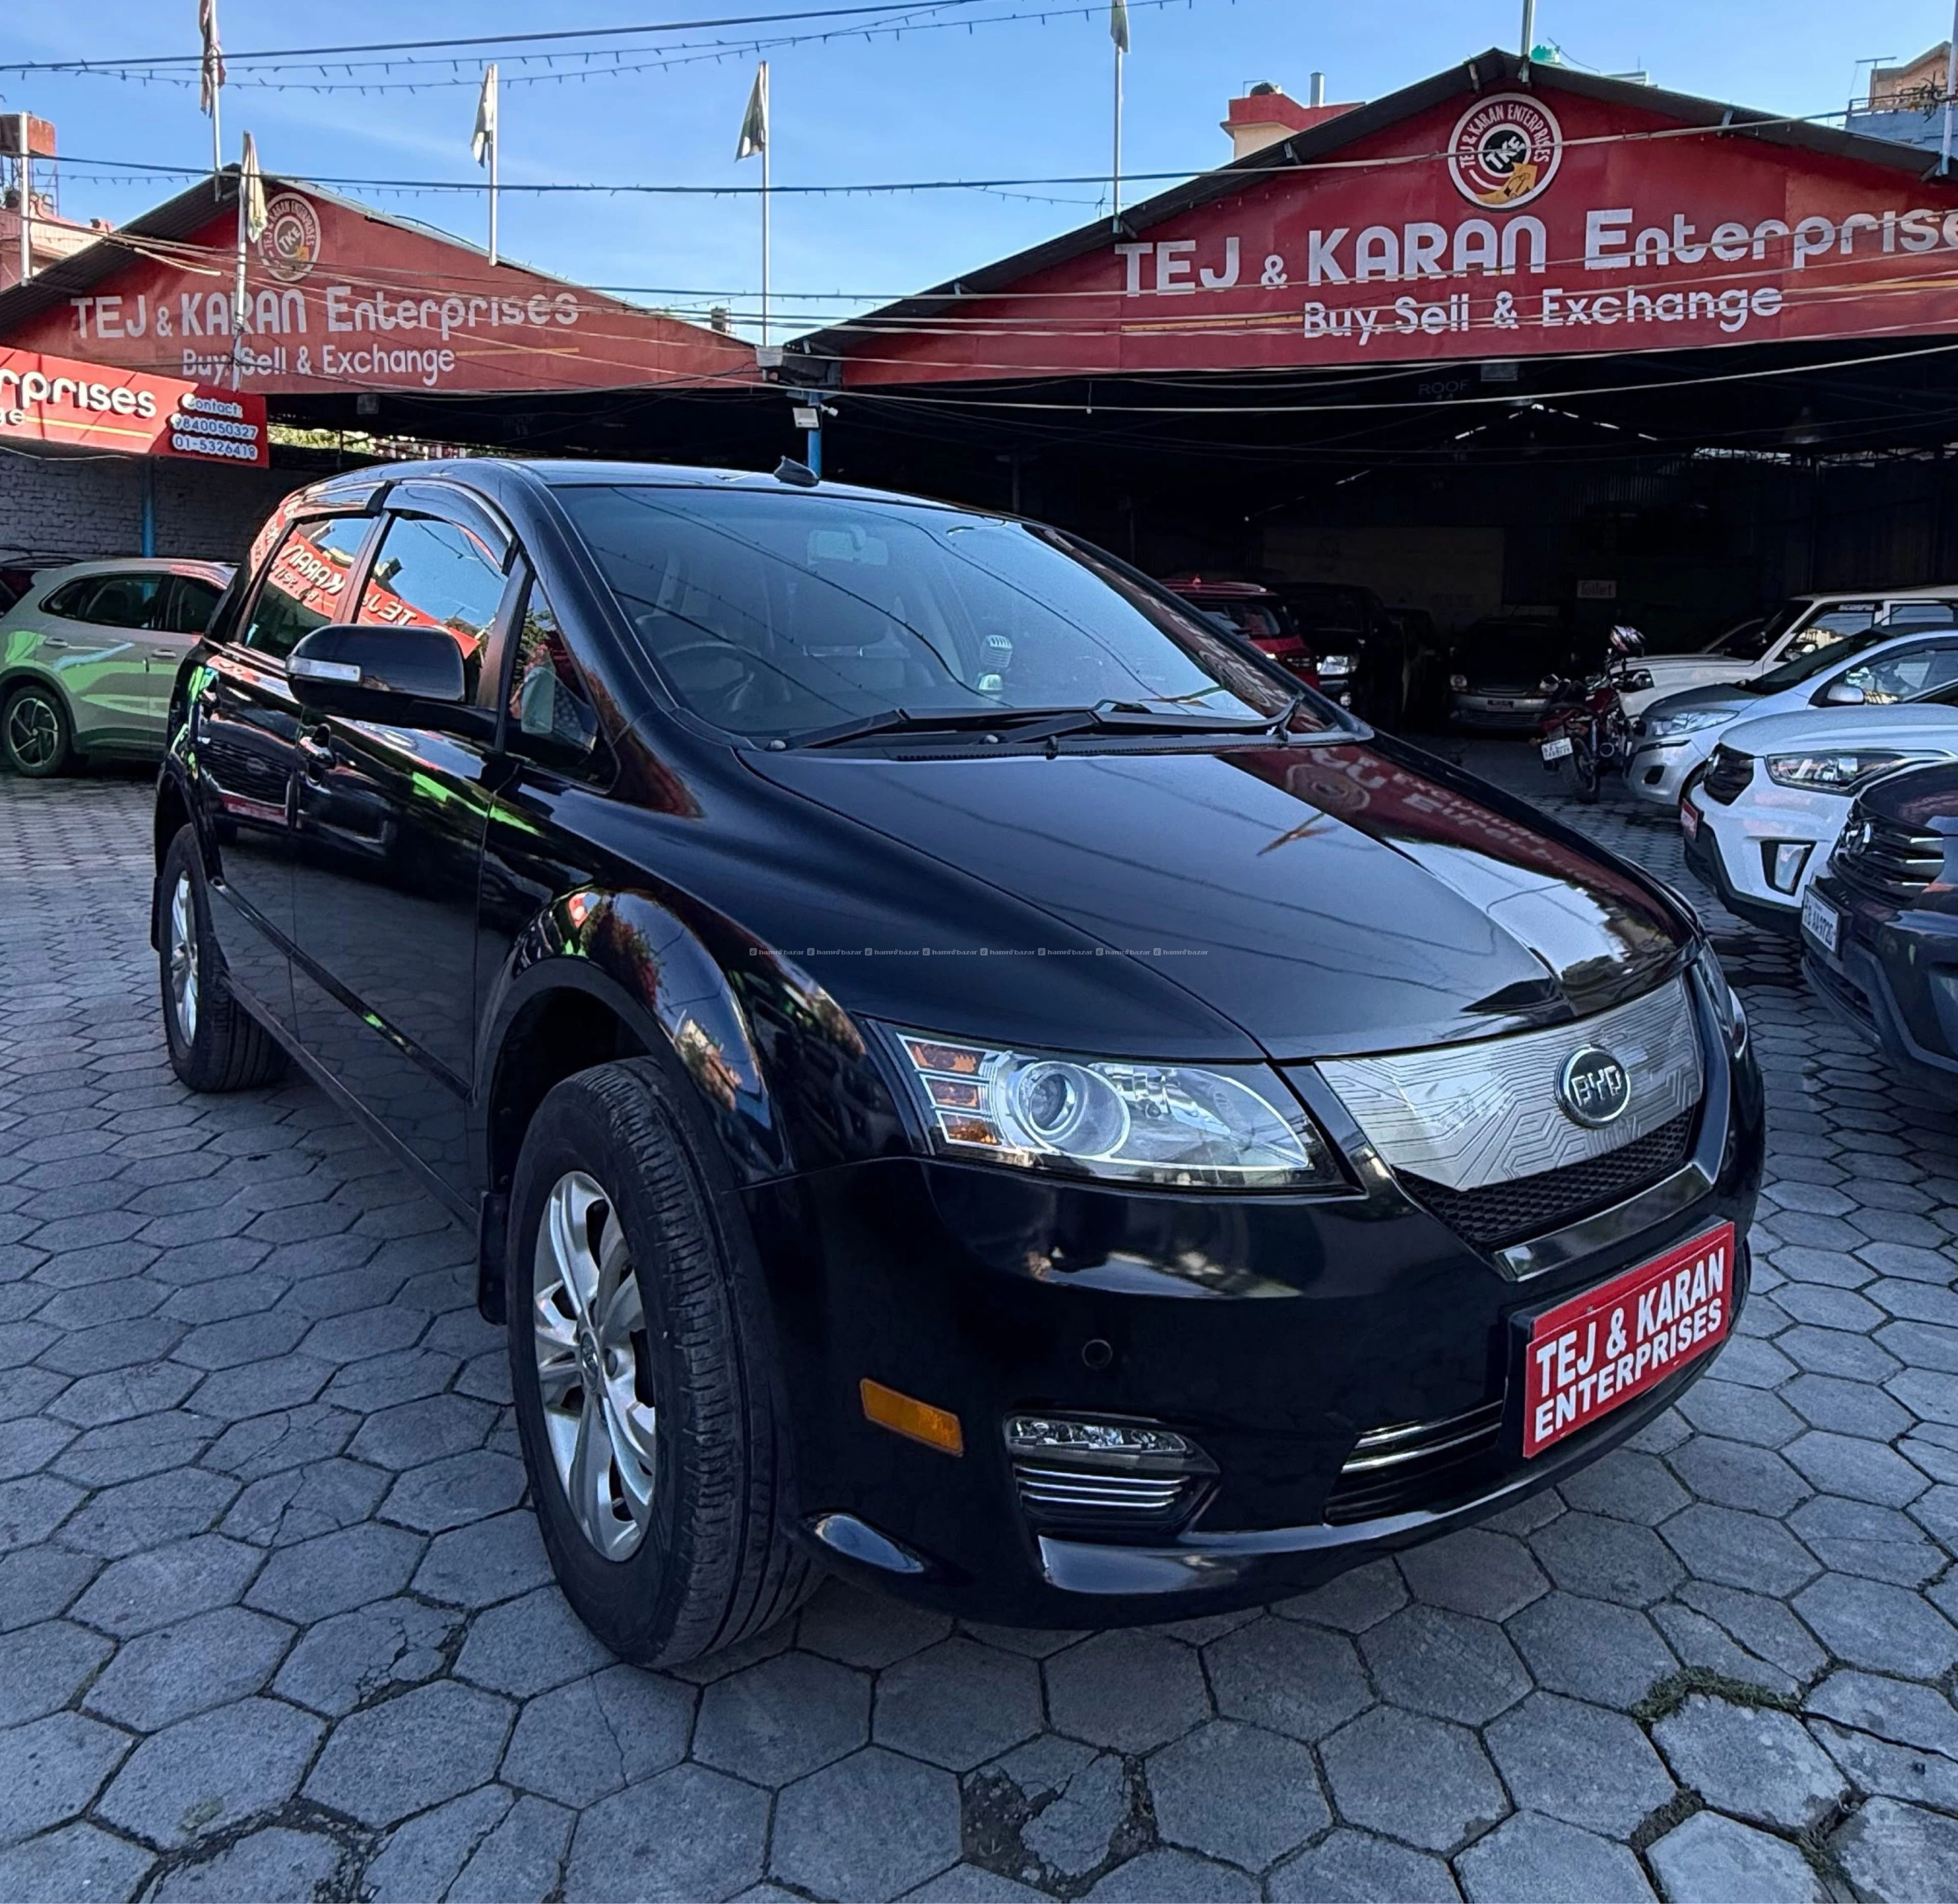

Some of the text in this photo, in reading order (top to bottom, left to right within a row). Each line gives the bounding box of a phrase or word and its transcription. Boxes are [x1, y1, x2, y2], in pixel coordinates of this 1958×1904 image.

[1459, 104, 1552, 168] TEJ & KARAN ENTERPRISES
[1485, 135, 1527, 170] TKE
[279, 226, 301, 251] TKE
[1114, 236, 1240, 297] TEJ
[1260, 254, 1289, 290] &
[1308, 215, 1547, 287] KARAN
[70, 286, 579, 341] TEJ & KARAN Enterprises
[1395, 293, 1469, 335] Sell
[1493, 291, 1519, 329] &
[1542, 286, 1783, 332] Exchange
[241, 346, 287, 375] Sell
[297, 345, 312, 374] &
[322, 343, 455, 387] Exchange
[1571, 1065, 1621, 1107] BYD
[1536, 1246, 1724, 1398] TEJ & KARAN
[1535, 1298, 1722, 1443] ENTERPRISES
